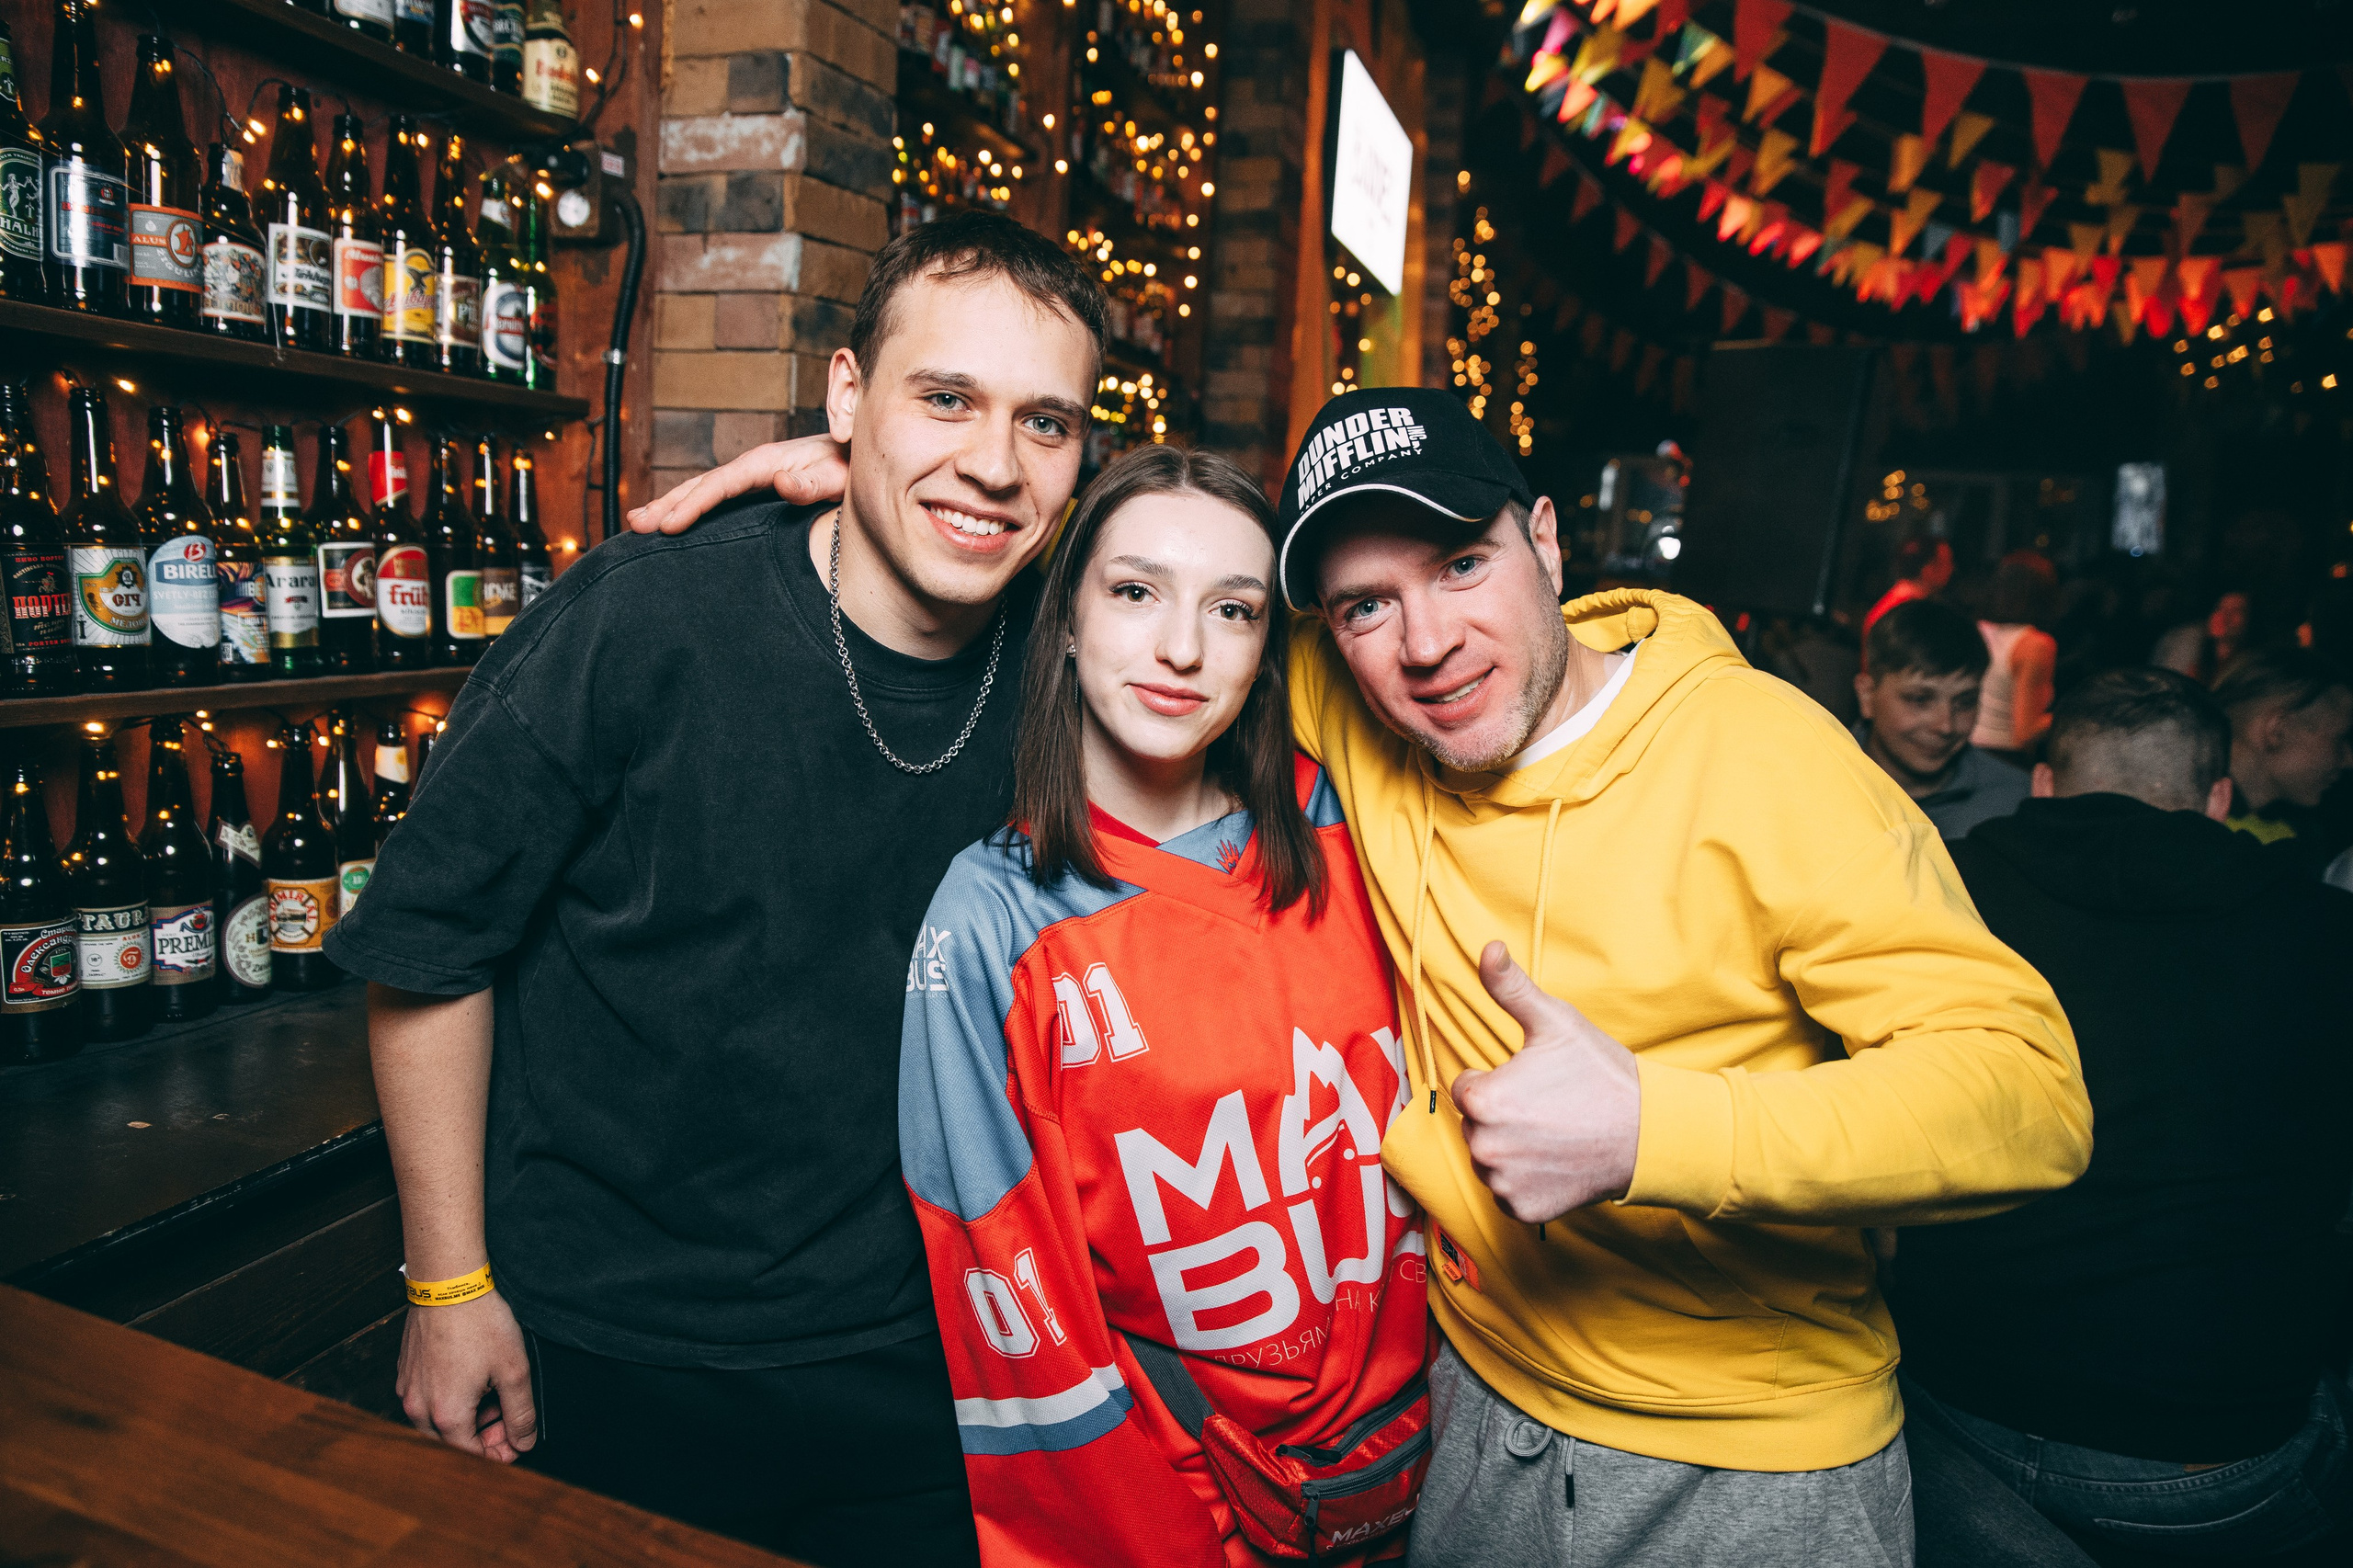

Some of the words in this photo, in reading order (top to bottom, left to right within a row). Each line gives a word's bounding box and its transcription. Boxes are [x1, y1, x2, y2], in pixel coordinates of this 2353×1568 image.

[132, 234, 167, 246] ALUS
[1297, 407, 1415, 485] DUNDER
[1297, 426, 1412, 510] MIFFLIN
[1300, 483, 1333, 515] APER
[1340, 449, 1423, 480] COMPANY
[911, 920, 952, 962] AX
[963, 1246, 1068, 1359] 01
